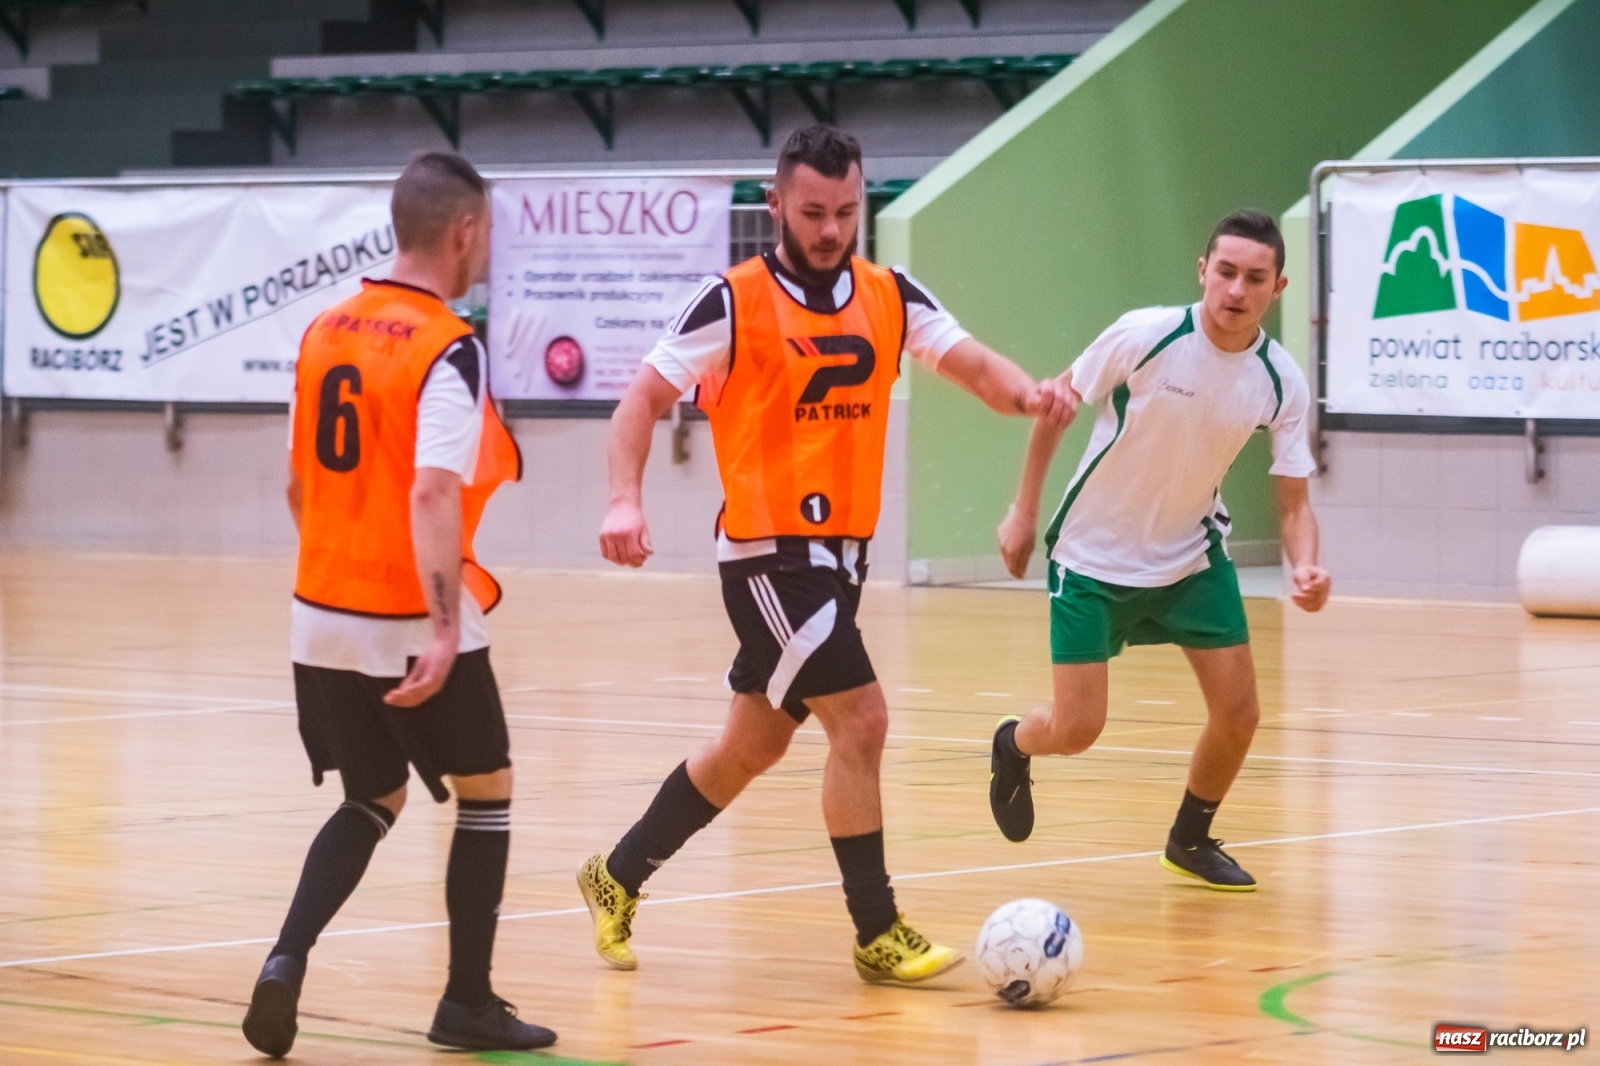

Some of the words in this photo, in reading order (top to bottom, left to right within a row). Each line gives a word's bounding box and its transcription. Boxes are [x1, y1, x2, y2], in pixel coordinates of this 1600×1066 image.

[520, 190, 699, 236] MIESZKO
[139, 309, 200, 361] JEST
[206, 293, 233, 328] W
[242, 224, 393, 316] PORZĄDKU
[30, 345, 122, 372] RACIBÓRZ
[1369, 330, 1461, 366] powiat
[1369, 370, 1448, 388] zielona
[1468, 375, 1523, 391] oaza
[316, 364, 362, 473] 6
[795, 403, 872, 422] PATRICK
[809, 496, 822, 522] 1
